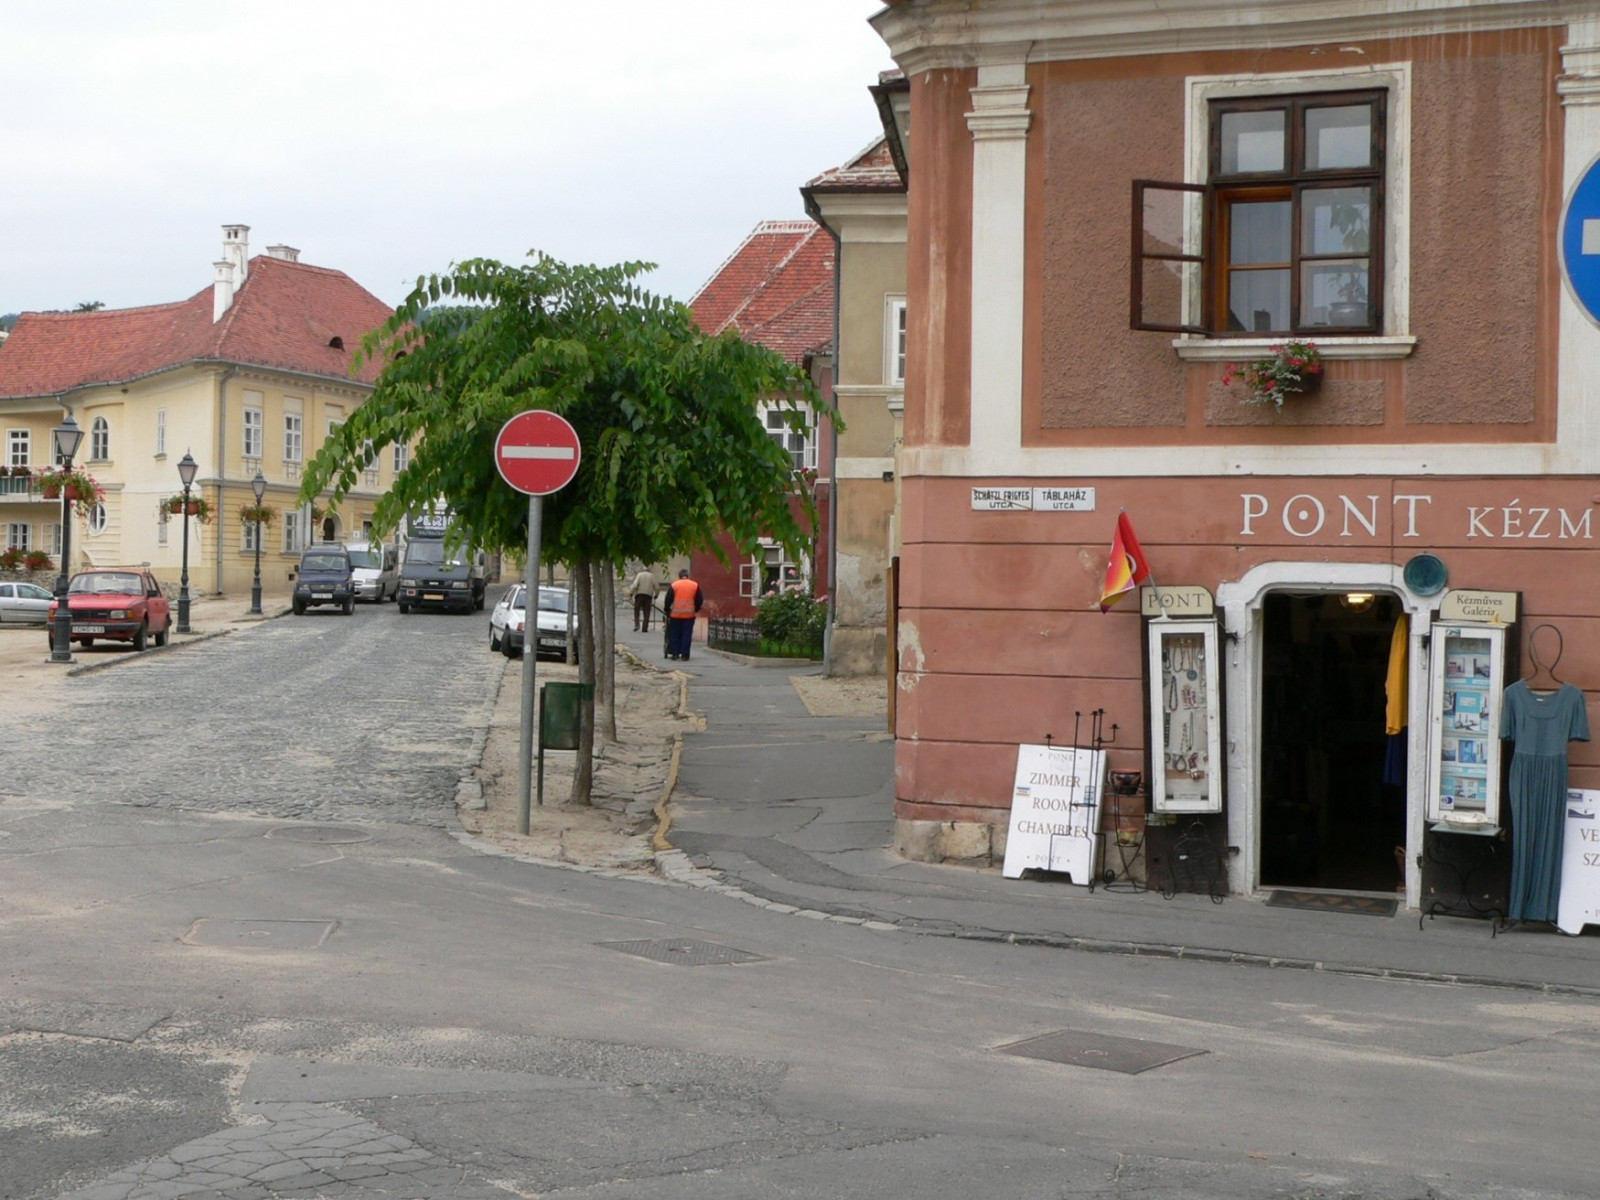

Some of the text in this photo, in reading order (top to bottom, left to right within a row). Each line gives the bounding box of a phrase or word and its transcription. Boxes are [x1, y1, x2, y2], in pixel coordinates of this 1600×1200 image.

[1042, 488, 1087, 501] TÁBLAHÁZ
[989, 501, 1014, 509] UTCA
[1239, 494, 1432, 537] PONT
[1148, 593, 1206, 608] PONT
[1456, 594, 1503, 606] Kézműves
[1462, 605, 1496, 616] Galéria
[1048, 752, 1075, 762] PONT
[1029, 772, 1081, 788] ZIMMER
[1032, 797, 1079, 812] ROOMS
[1017, 820, 1088, 839] CHAMBRES
